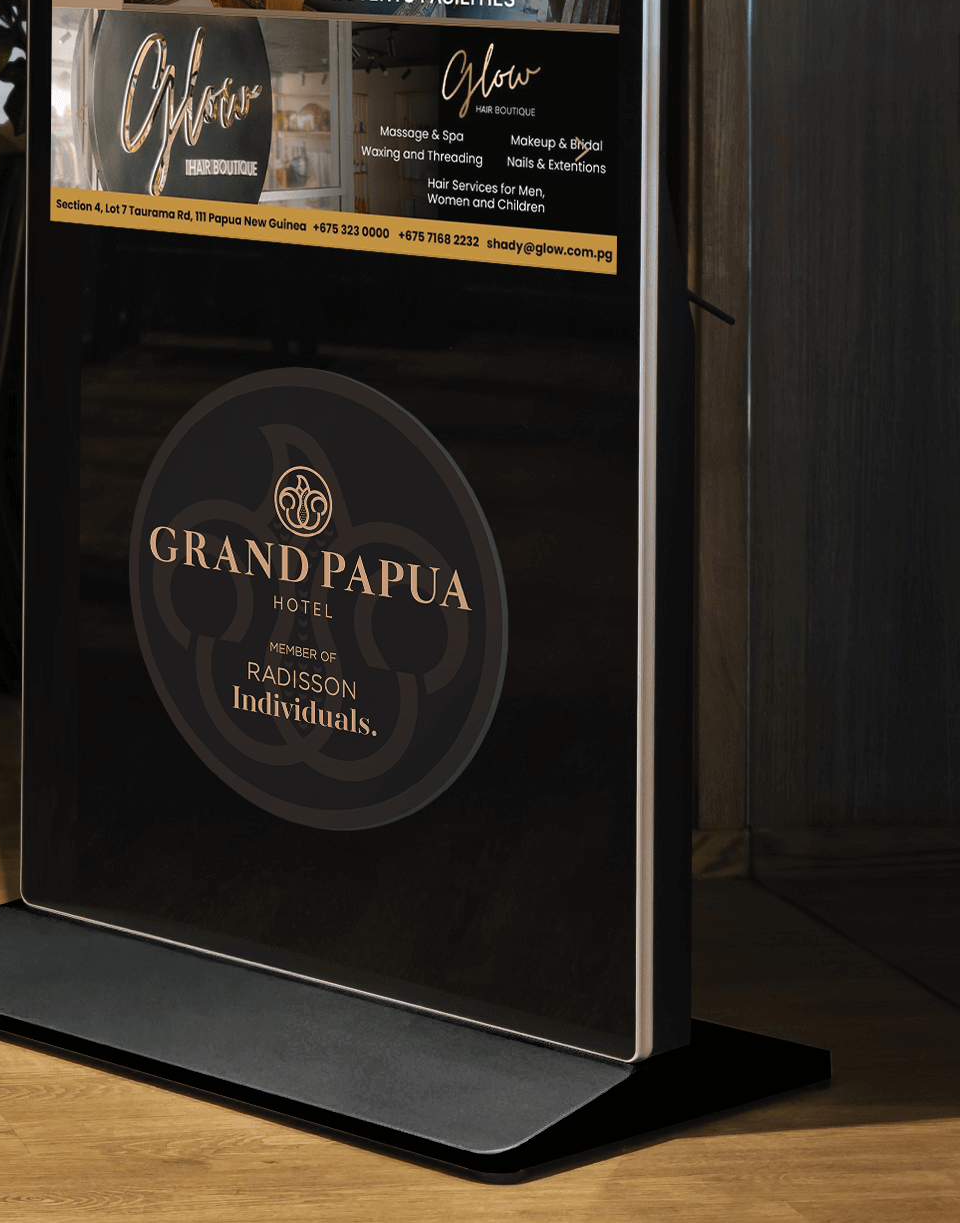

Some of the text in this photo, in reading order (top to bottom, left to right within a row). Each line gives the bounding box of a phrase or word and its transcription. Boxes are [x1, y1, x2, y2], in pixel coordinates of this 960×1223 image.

[476, 105, 536, 117] HAIR BOUTIQUE
[380, 126, 464, 145] Massage & Spa
[511, 134, 603, 151] Makeup & Bridal
[361, 145, 483, 168] Waxing and Threading
[507, 156, 607, 174] Nails & Extentions
[213, 159, 258, 176] BOUTIQUE
[428, 178, 545, 198] Hair Services for Men,
[427, 193, 545, 213] Women and Children
[56, 199, 613, 263] Section 4, Lot 7 Taurama Rd, 111 Papua New Guinea +675 323 0000 +675 7168 2232 shady@glow.com.pg
[149, 526, 472, 611] GRAND PAPUA
[273, 595, 333, 619] HOTEL
[269, 641, 337, 664] MEMBER OF
[247, 661, 356, 700] RADISSON
[232, 684, 378, 737] Individuals.
